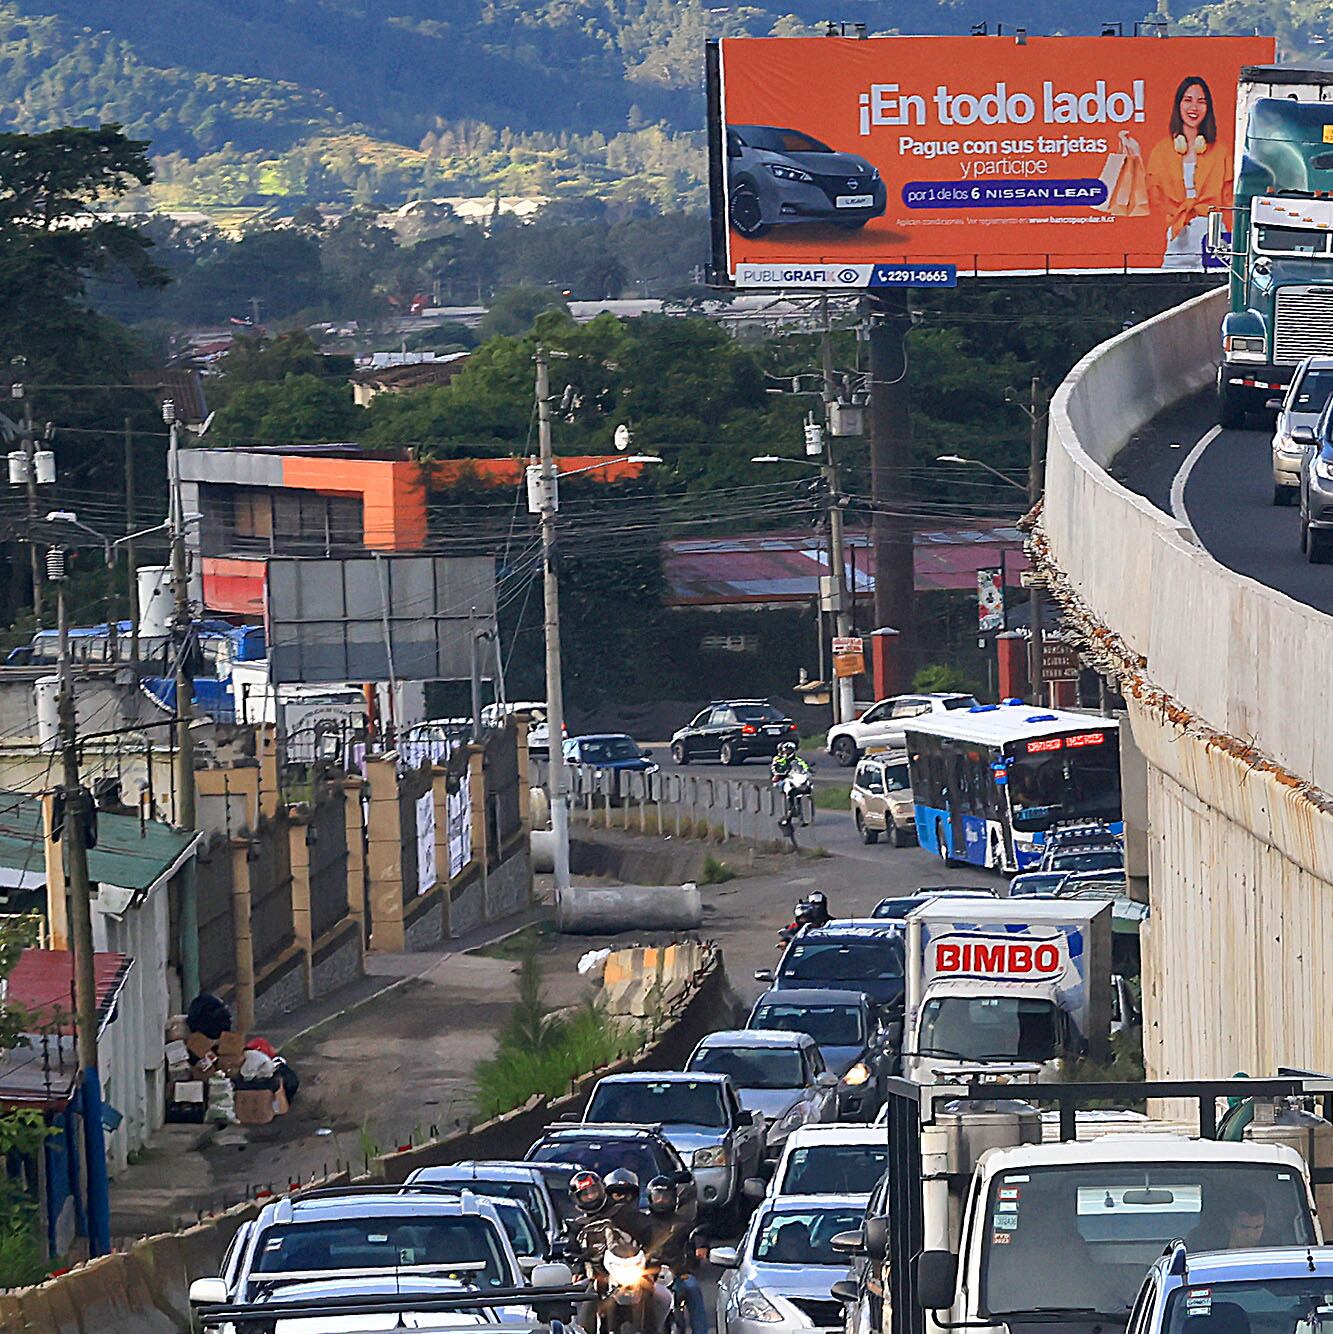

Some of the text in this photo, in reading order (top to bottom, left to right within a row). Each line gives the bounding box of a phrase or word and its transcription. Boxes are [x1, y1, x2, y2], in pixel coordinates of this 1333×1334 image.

[858, 79, 1145, 136] ¡En todo lado!
[899, 135, 1108, 159] Pague con sus tarjetas
[960, 156, 1048, 179] y participe
[908, 187, 1102, 202] por 1 de los 6 NISSAN LEAF
[935, 944, 1060, 973] BIMBO
